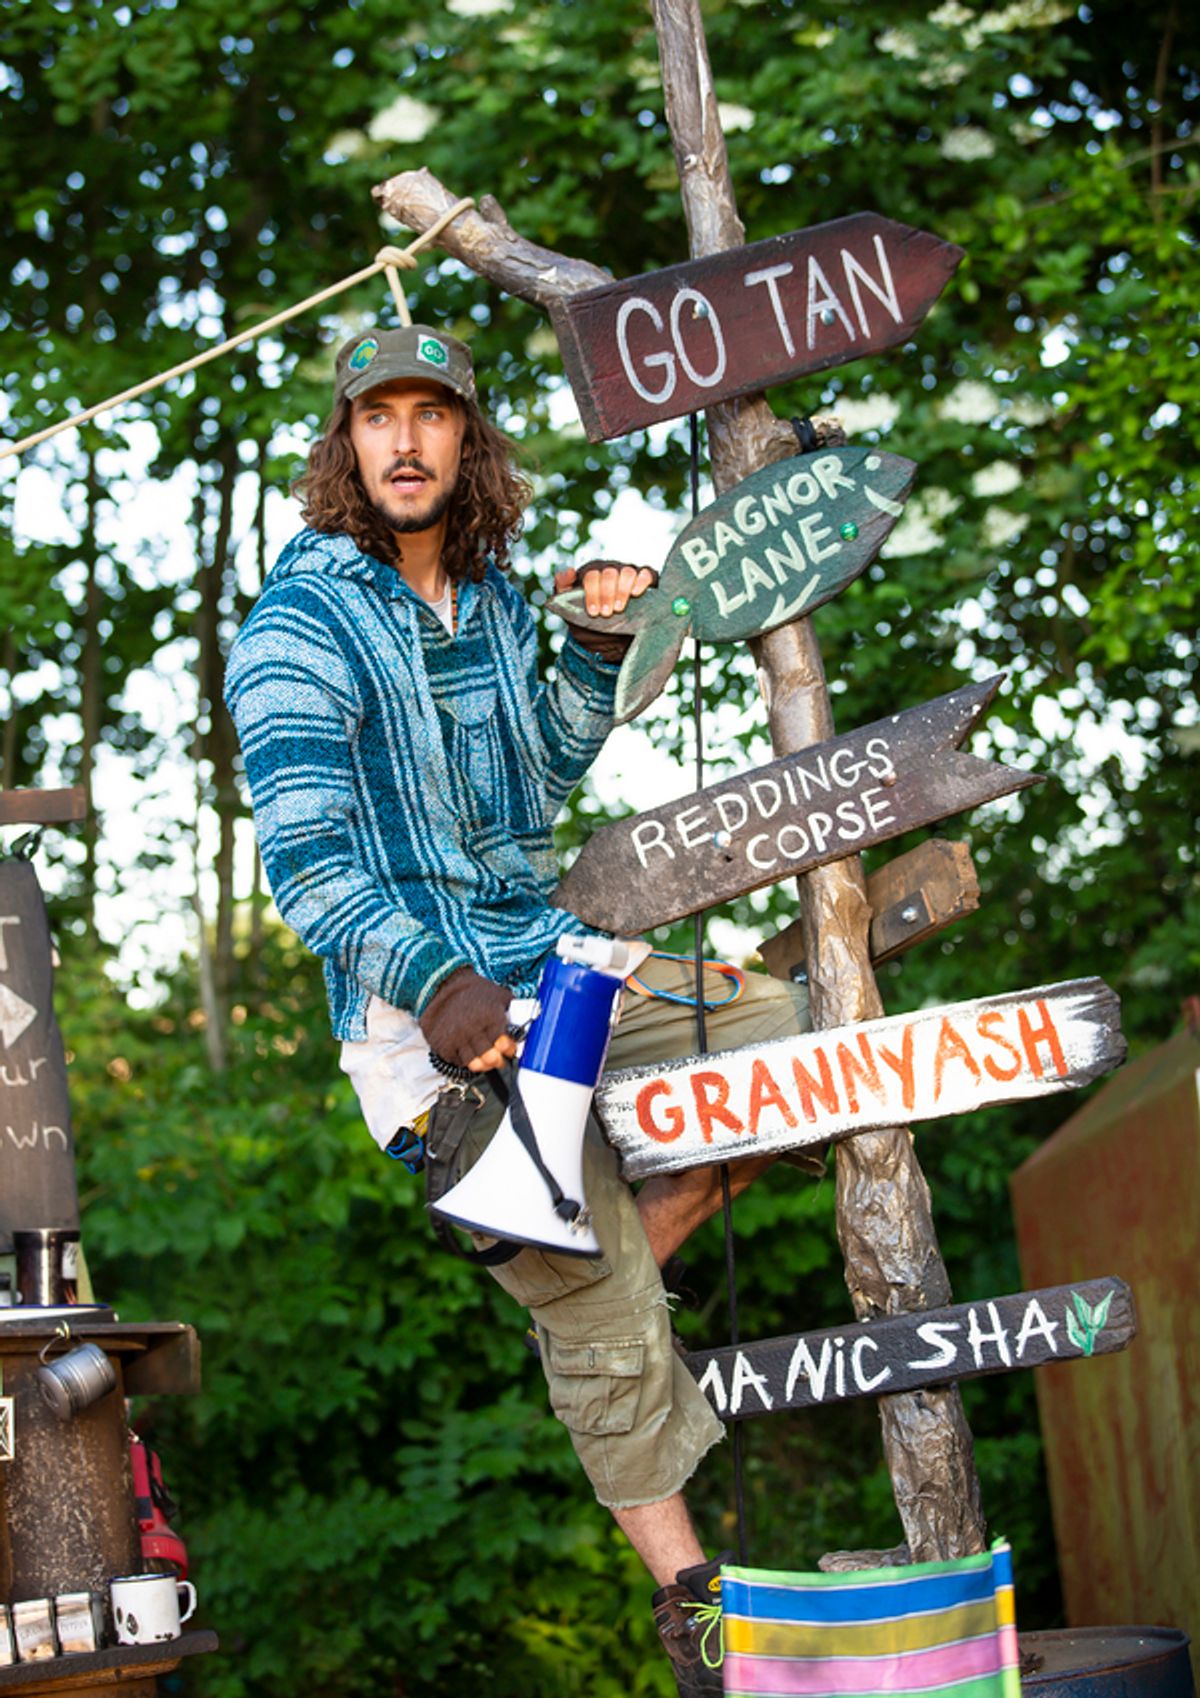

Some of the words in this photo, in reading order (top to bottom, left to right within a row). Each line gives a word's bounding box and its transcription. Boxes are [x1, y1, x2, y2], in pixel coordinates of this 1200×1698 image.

[616, 288, 727, 404] GO
[744, 234, 904, 359] TAN
[680, 454, 856, 580] BAGNOR
[710, 511, 843, 619] LANE
[630, 738, 895, 869] REDDINGS
[746, 787, 896, 870] COPSE
